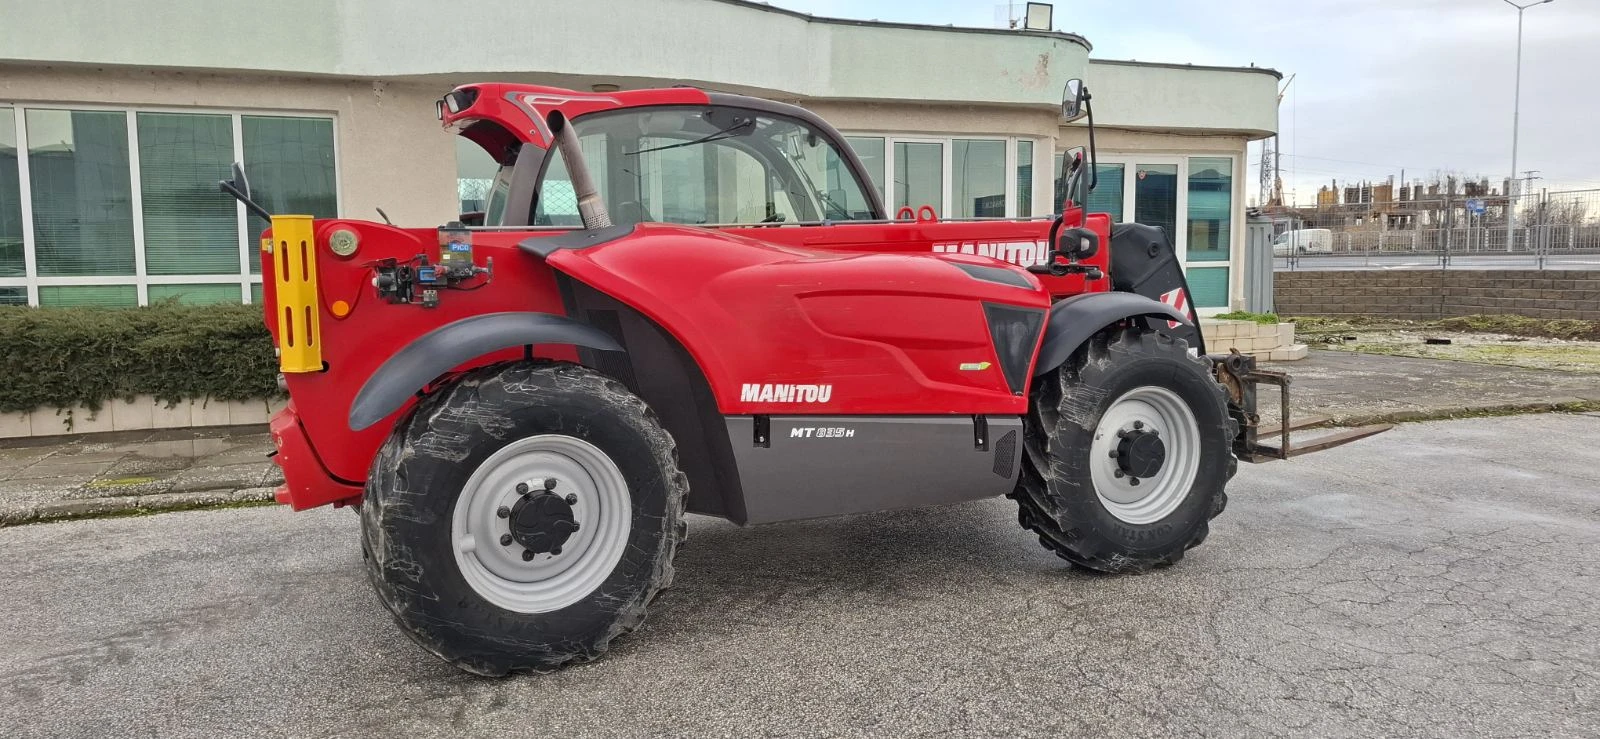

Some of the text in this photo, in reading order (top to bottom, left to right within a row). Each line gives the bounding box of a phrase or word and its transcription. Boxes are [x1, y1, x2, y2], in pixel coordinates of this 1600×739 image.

[452, 243, 469, 251] PICO
[740, 383, 832, 403] MANITOU
[790, 427, 816, 438] MT
